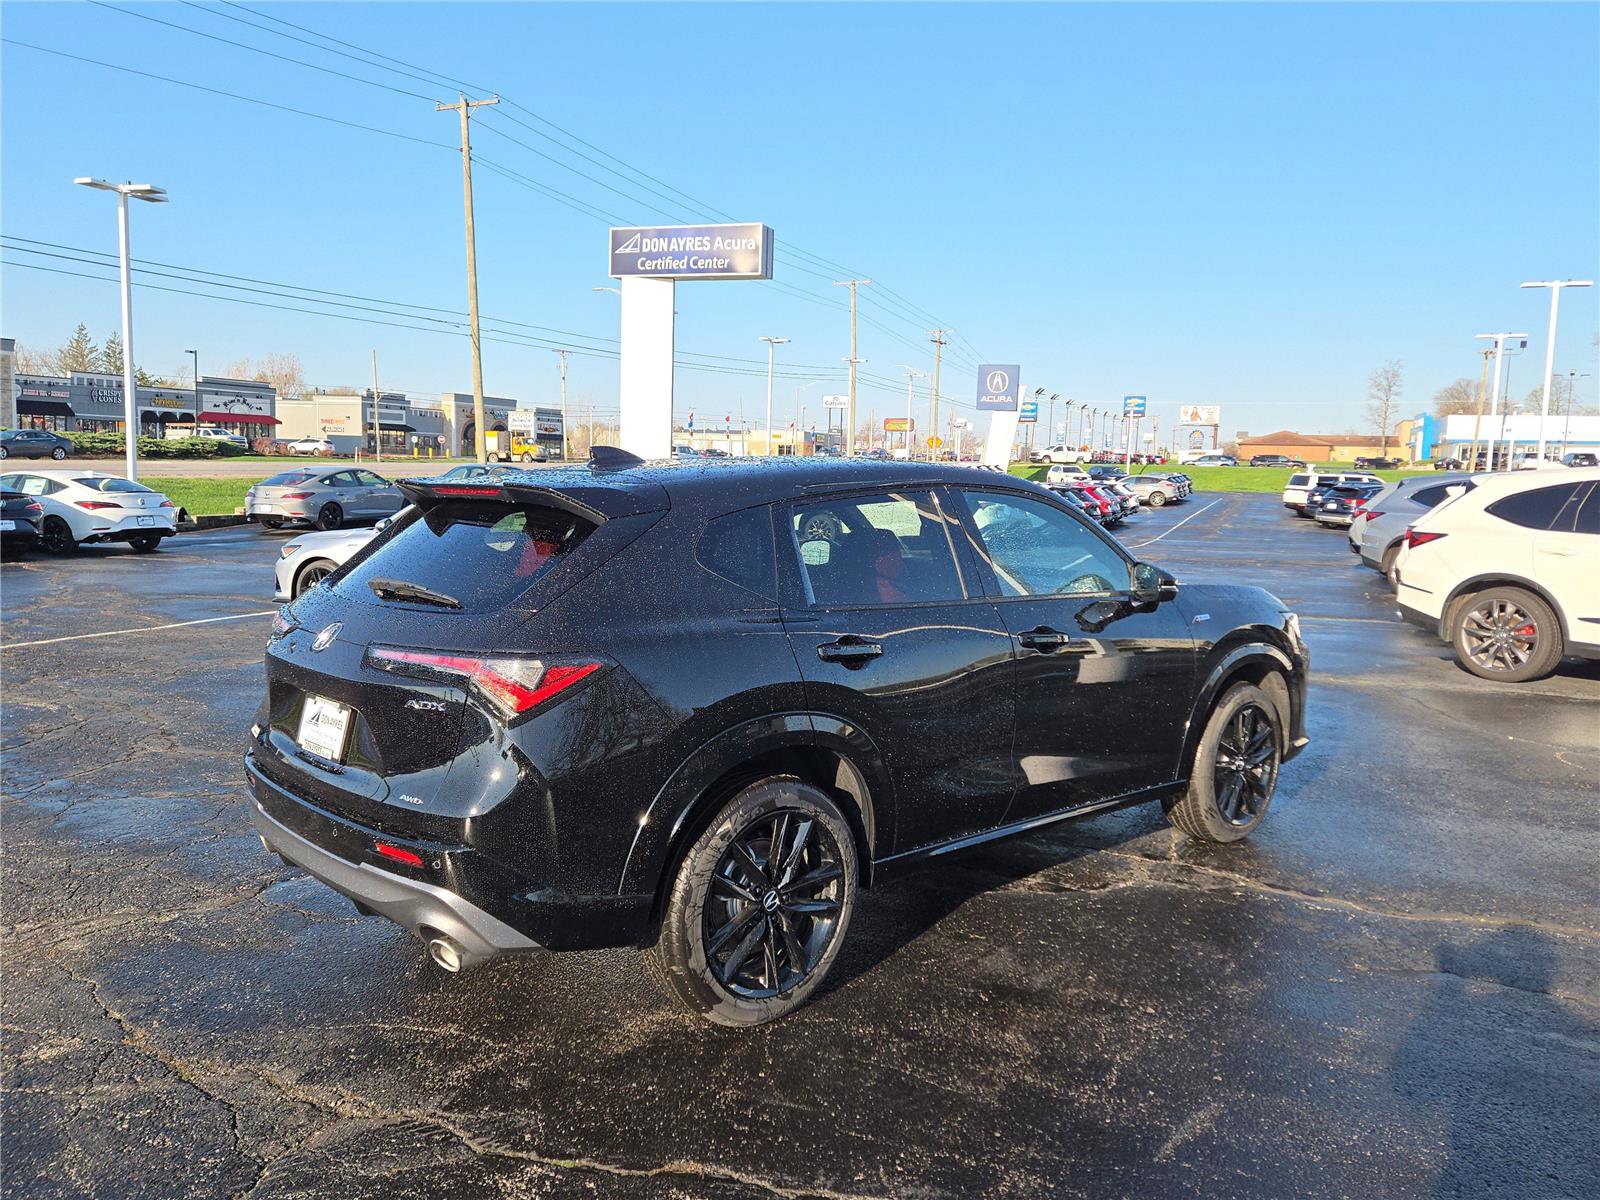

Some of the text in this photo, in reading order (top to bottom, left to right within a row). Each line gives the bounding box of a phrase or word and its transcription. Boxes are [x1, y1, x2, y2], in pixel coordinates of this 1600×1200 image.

[642, 236, 756, 253] DON AYRES Acura
[637, 255, 730, 271] Certified Center
[98, 389, 122, 397] CRISPY
[98, 396, 122, 404] CONES
[980, 395, 1013, 403] ACURA
[404, 699, 446, 711] ADX
[399, 794, 424, 804] AWD
